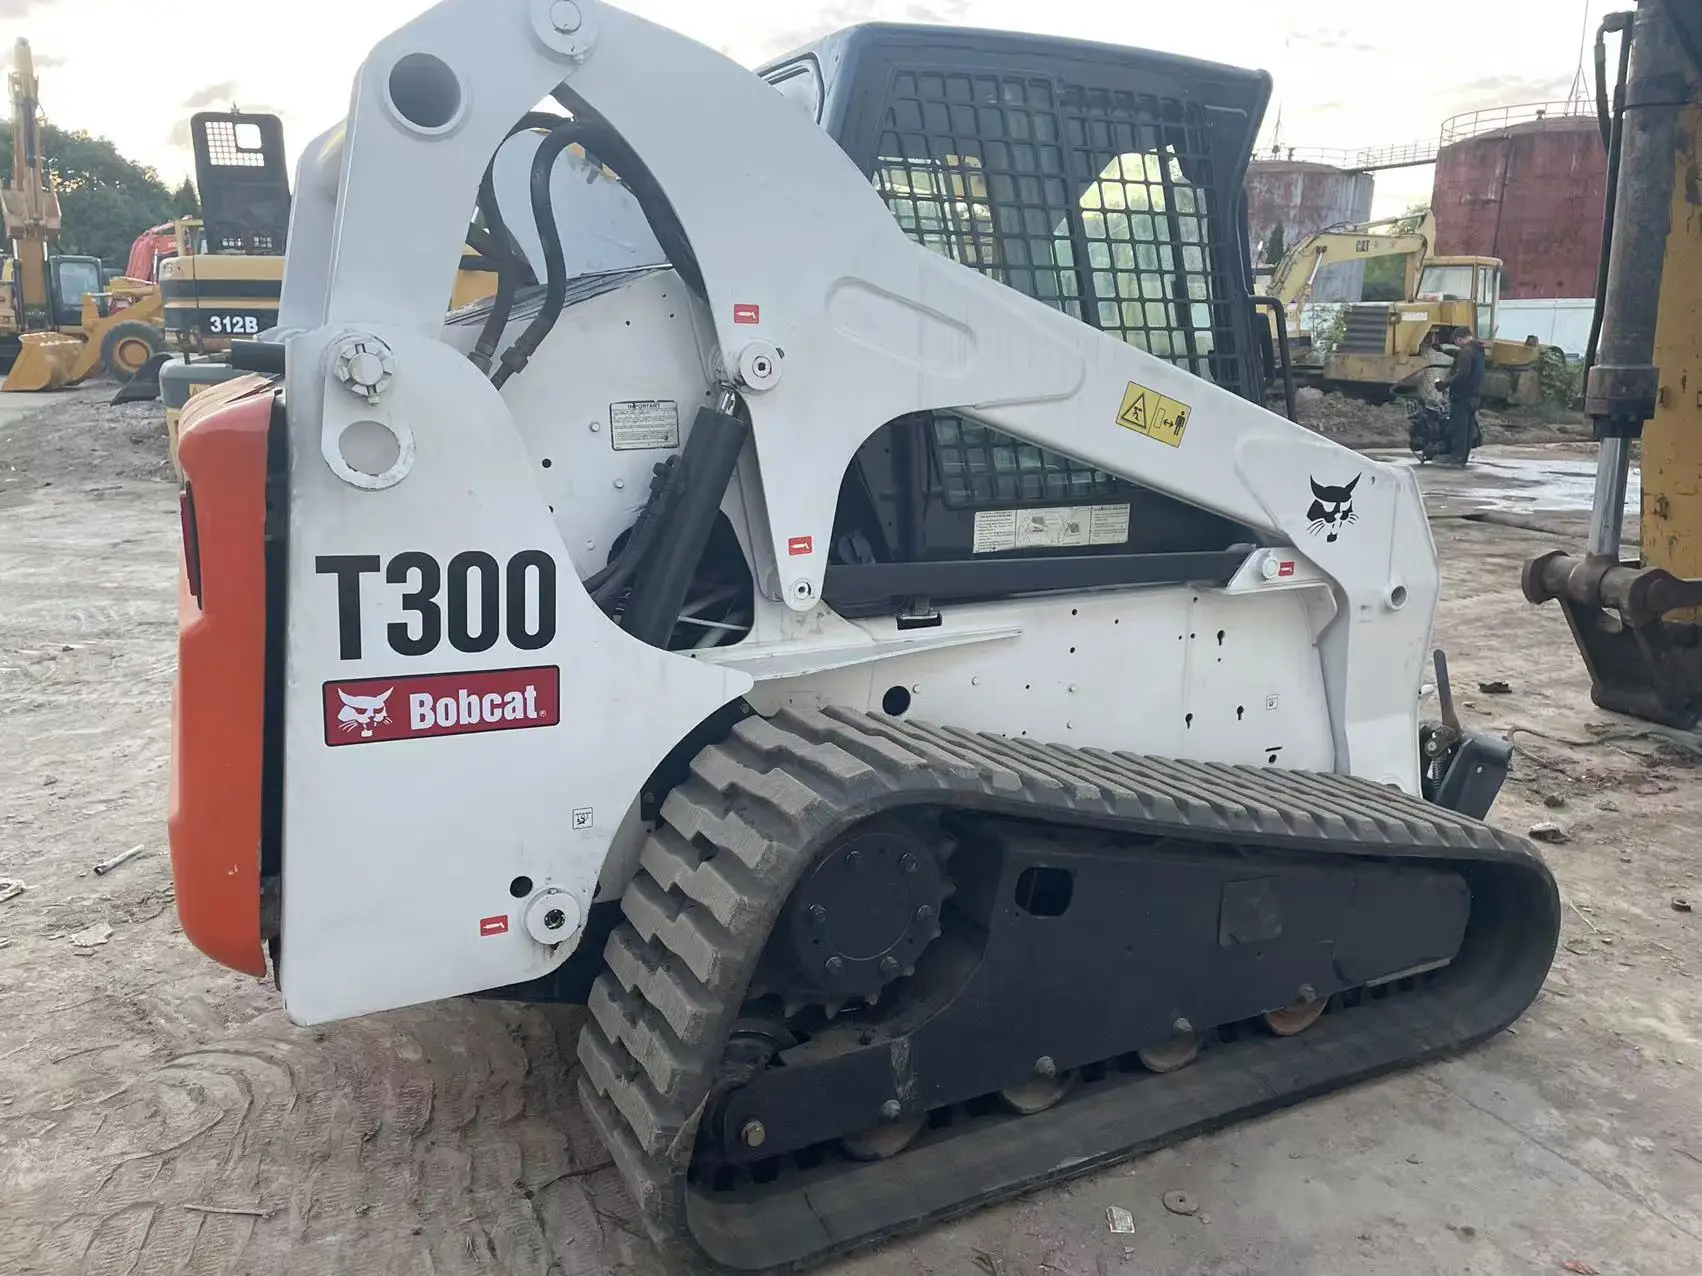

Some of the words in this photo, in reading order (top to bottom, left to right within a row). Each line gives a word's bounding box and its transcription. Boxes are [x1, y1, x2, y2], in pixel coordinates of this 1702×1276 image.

[1355, 240, 1370, 252] CAT
[209, 315, 259, 333] 312B
[315, 550, 557, 661] T300
[409, 685, 538, 730] Bobcat
